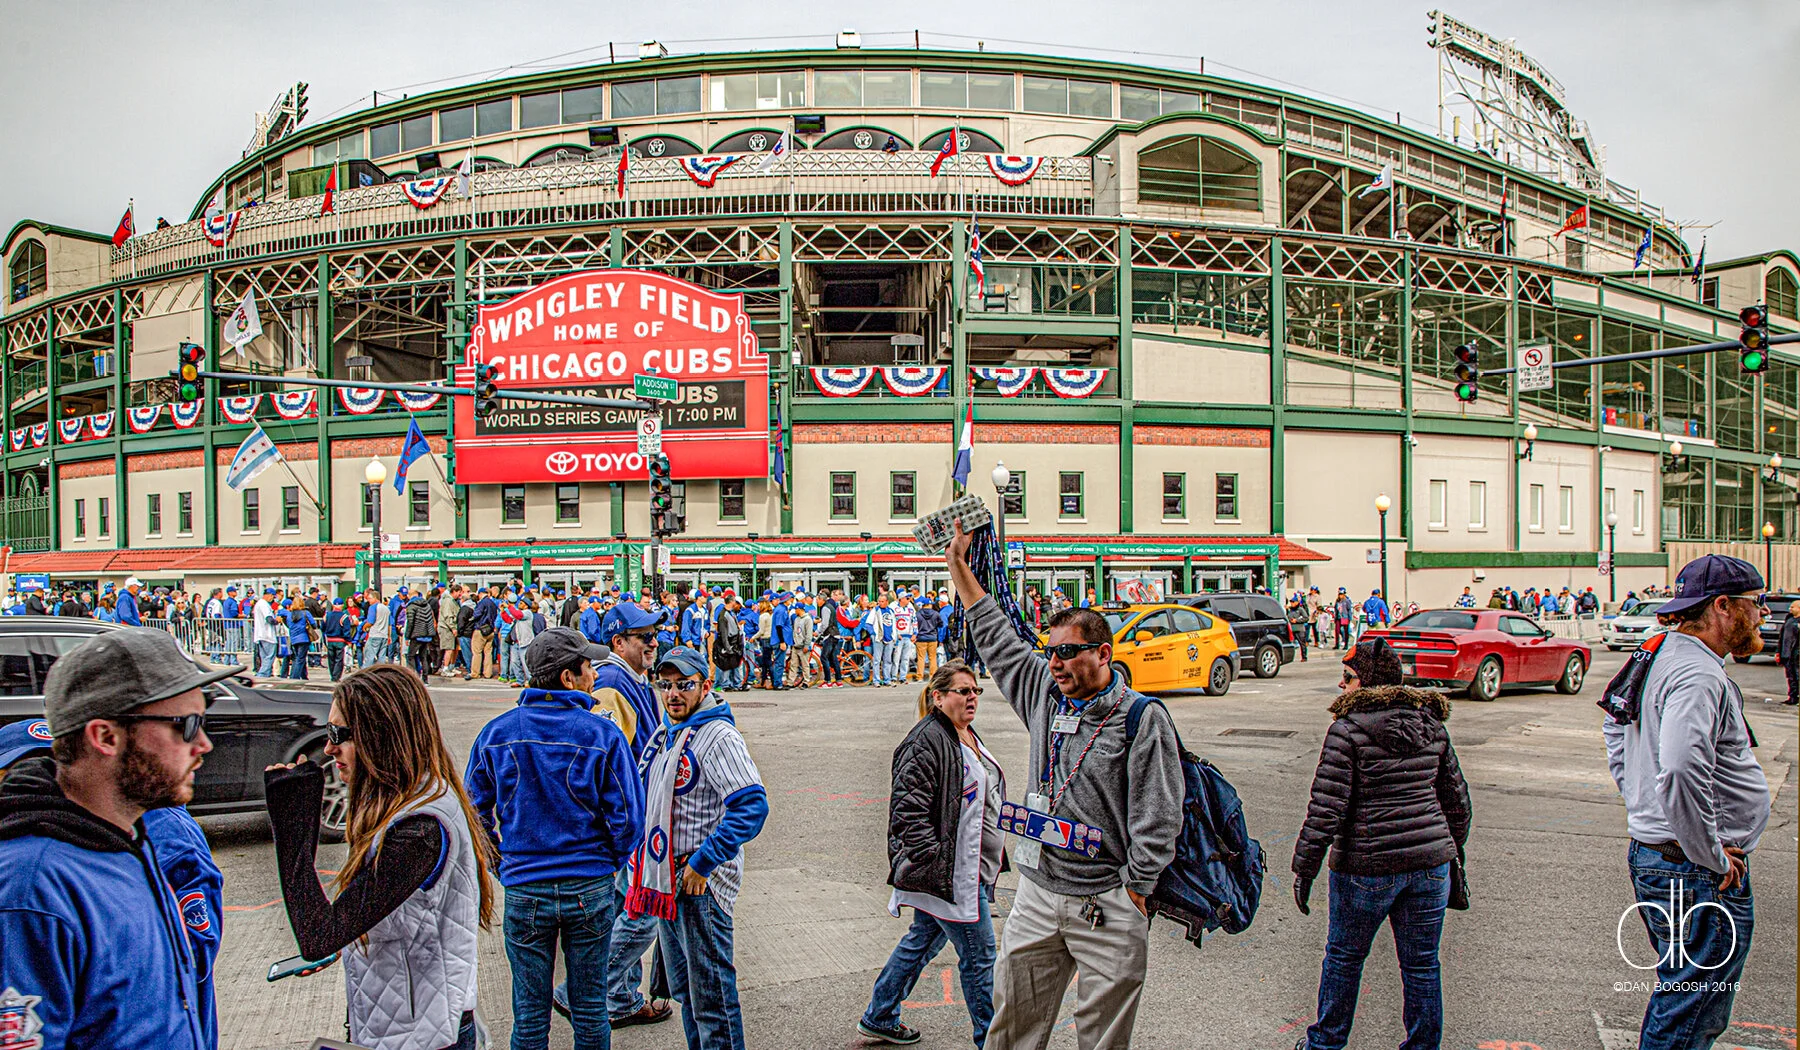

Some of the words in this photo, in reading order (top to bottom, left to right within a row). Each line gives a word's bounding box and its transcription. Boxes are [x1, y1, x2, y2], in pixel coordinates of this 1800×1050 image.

[488, 282, 626, 344] WRIGLEY
[640, 284, 731, 333] FIELD
[553, 323, 618, 341] HOME
[634, 321, 664, 337] OF
[489, 351, 627, 381] CHICAGO
[643, 347, 733, 374] CUBS
[642, 378, 669, 390] ADDISON
[658, 385, 718, 405] UBS
[484, 413, 541, 428] WORLD
[544, 411, 601, 426] SERIES
[605, 409, 648, 424] GAME
[677, 407, 708, 422] 7:00
[713, 407, 737, 421] PM
[581, 452, 668, 471] TOYOT
